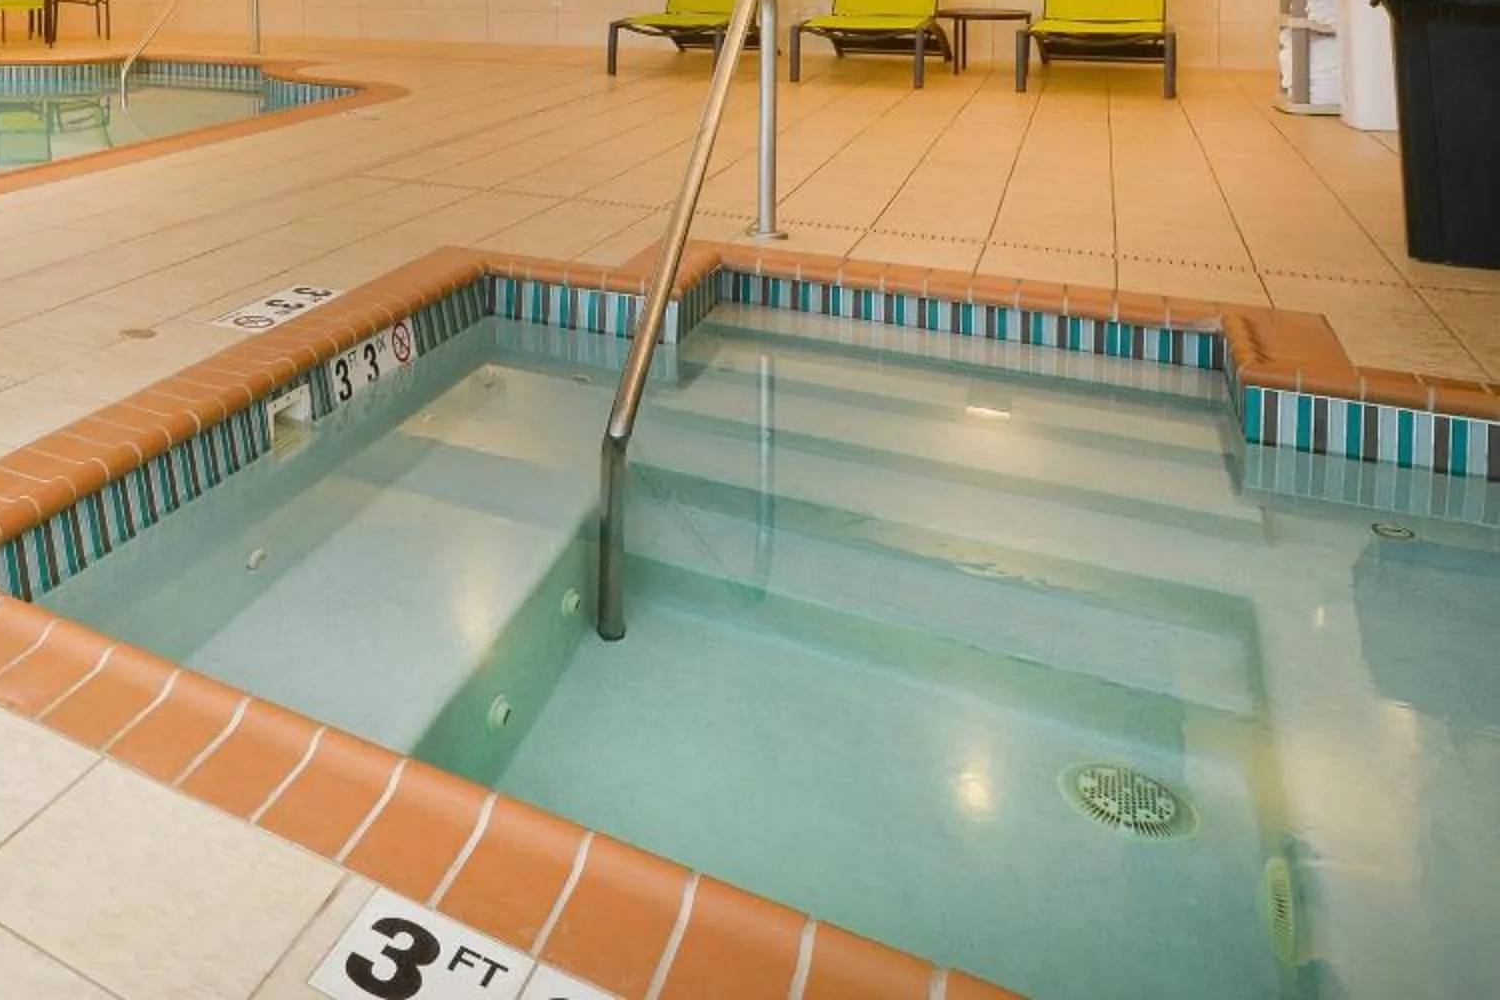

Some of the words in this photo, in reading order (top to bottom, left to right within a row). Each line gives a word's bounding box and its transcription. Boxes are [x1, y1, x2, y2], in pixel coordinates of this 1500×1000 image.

[336, 358, 353, 401] 3
[363, 343, 379, 382] 3
[345, 917, 442, 1000] 3
[447, 945, 509, 989] FT
